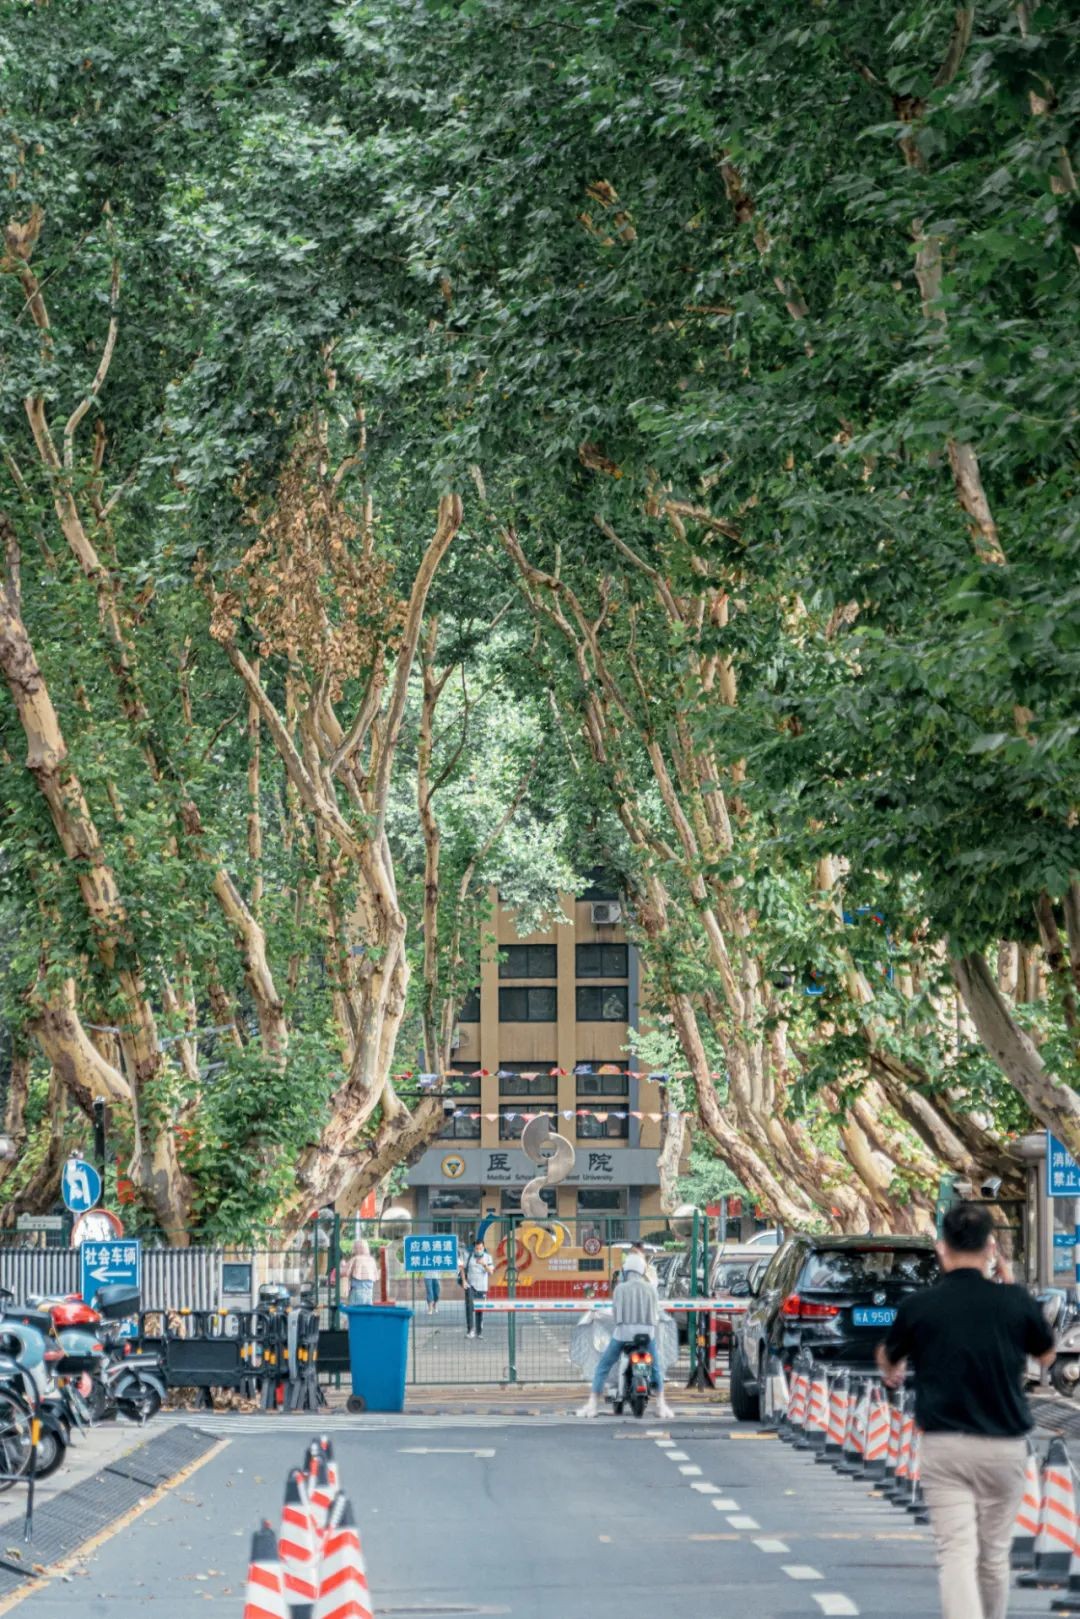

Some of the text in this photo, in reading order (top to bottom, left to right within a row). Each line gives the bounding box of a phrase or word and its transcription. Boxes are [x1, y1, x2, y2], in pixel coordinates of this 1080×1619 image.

[487, 1152, 613, 1173] 医院
[582, 1173, 613, 1181] University
[1053, 1171, 1080, 1187] 禁止
[410, 1240, 453, 1252] 应急通道
[85, 1246, 136, 1266] 社会车辆
[410, 1255, 453, 1267] 禁止停车
